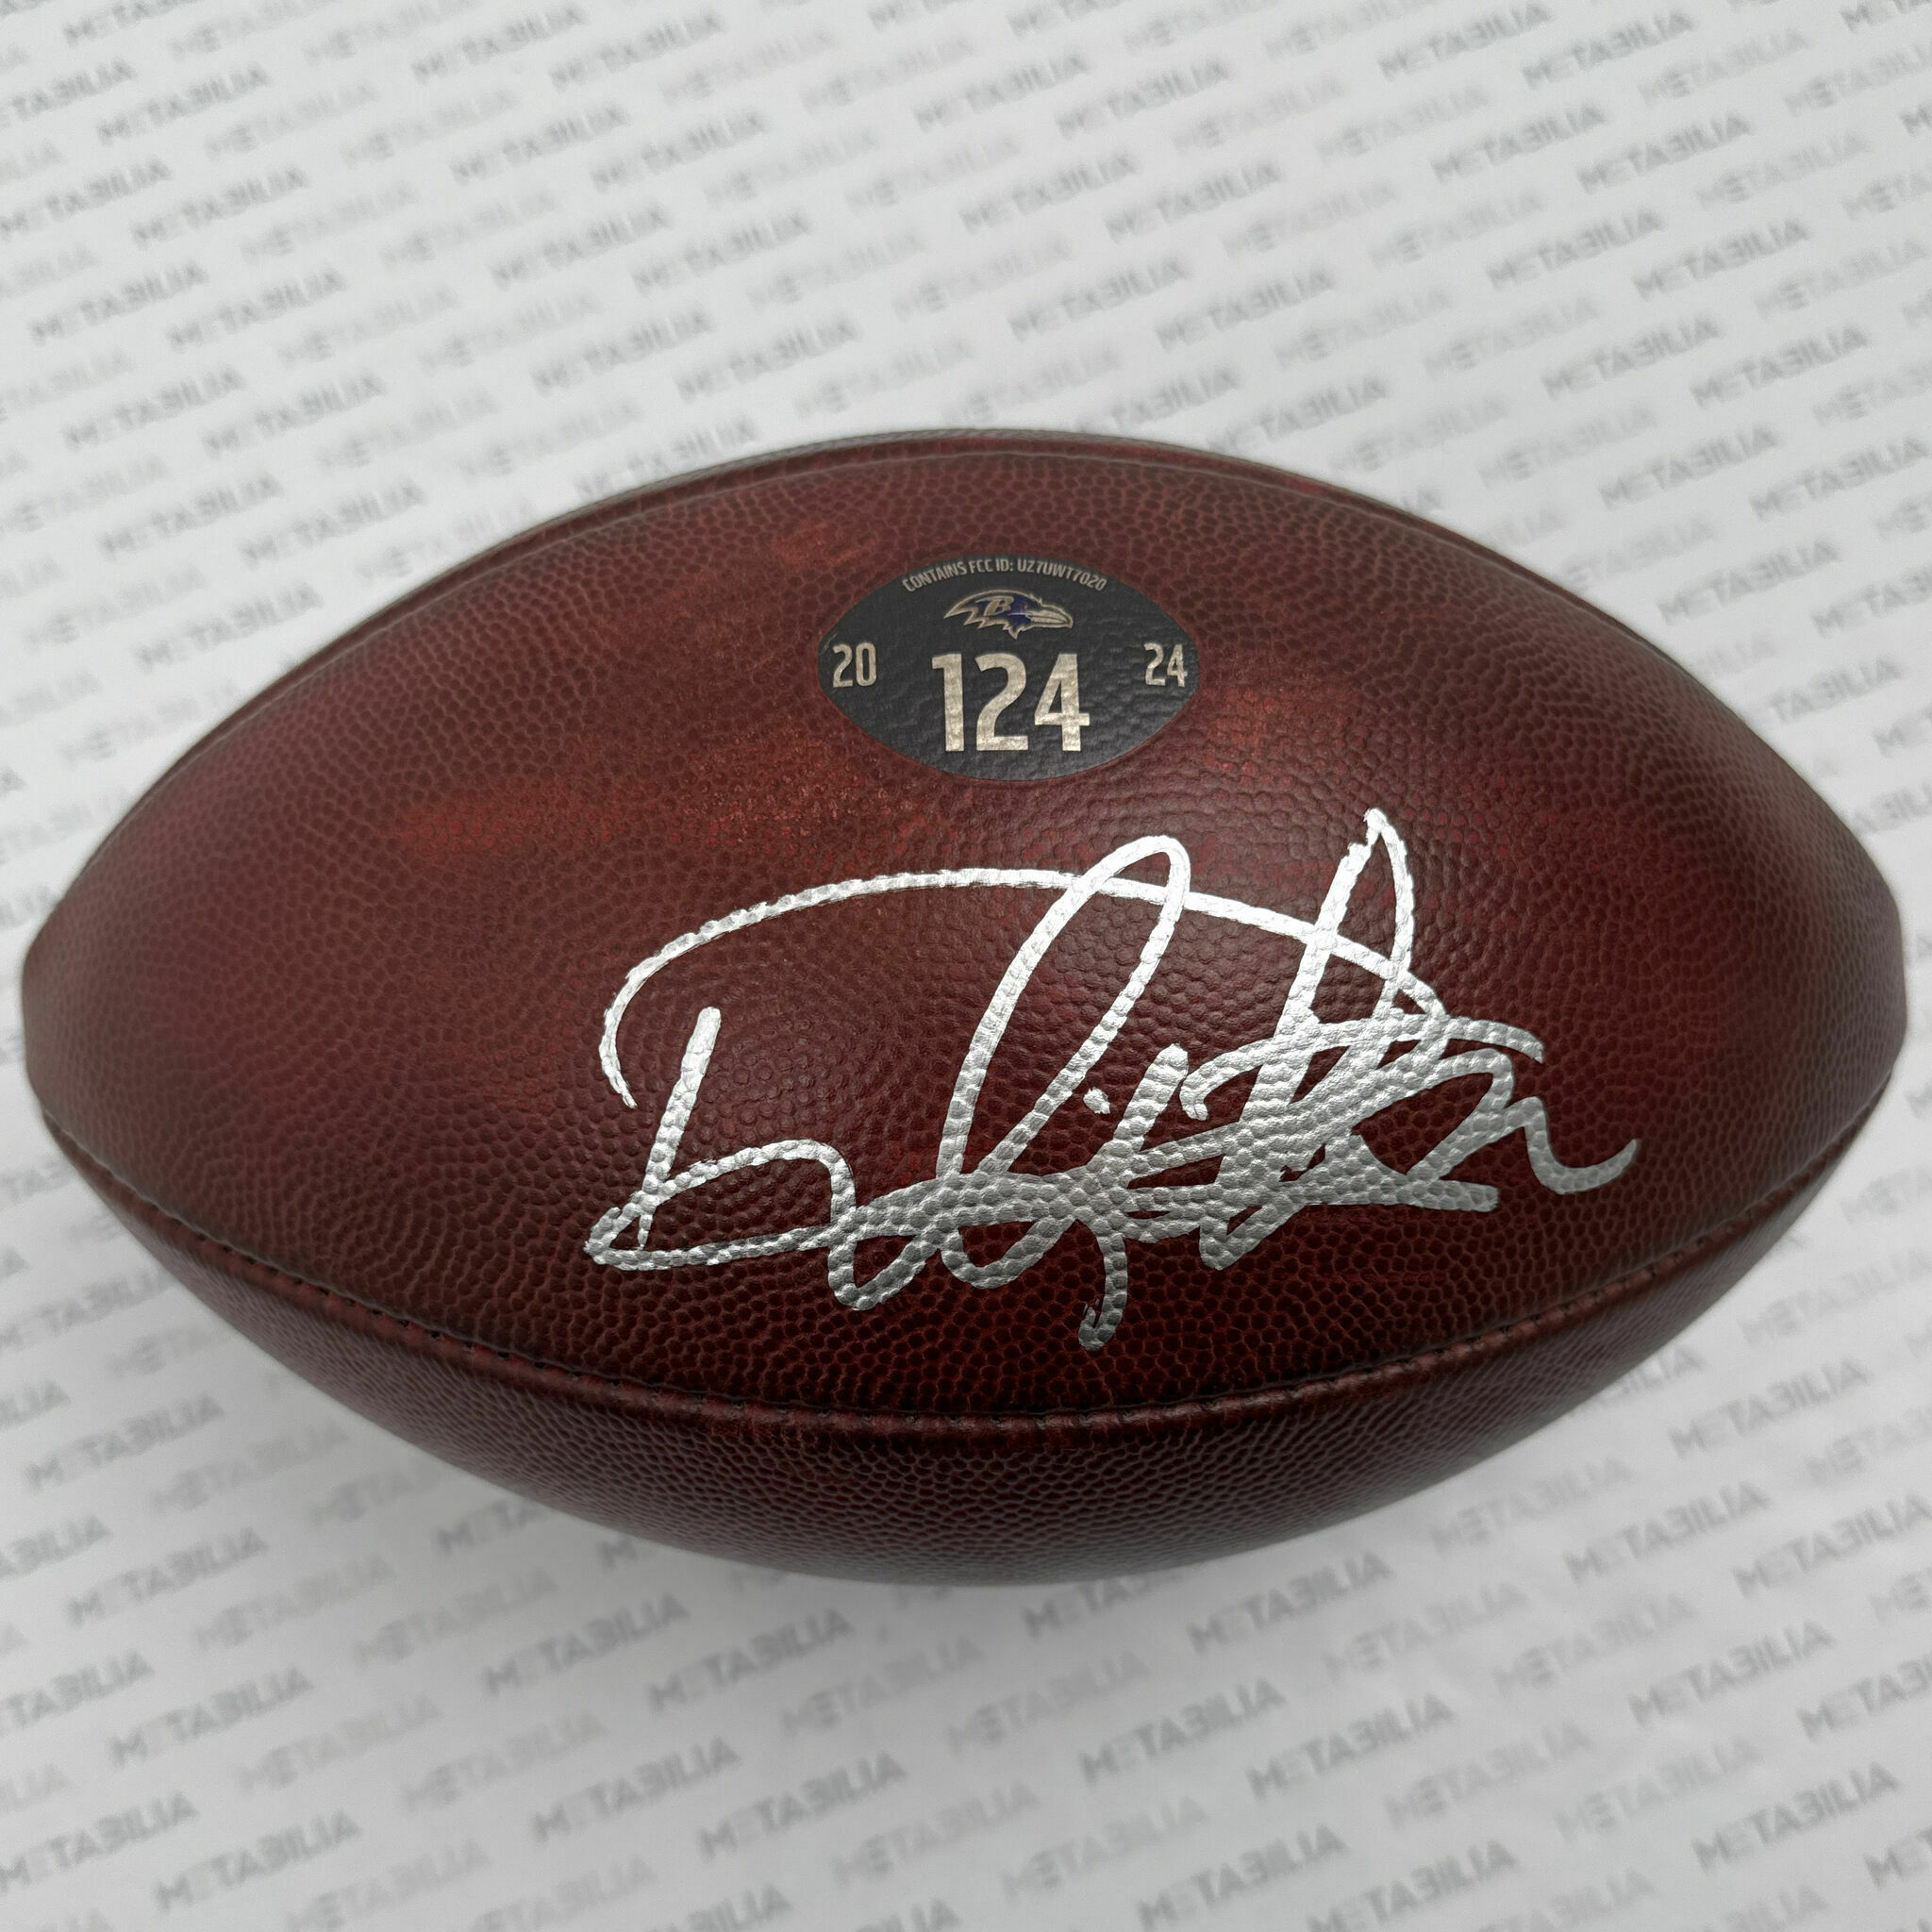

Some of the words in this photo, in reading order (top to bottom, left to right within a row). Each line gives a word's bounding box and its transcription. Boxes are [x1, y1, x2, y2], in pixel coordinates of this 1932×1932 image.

[902, 560, 968, 592] CONTAINS
[968, 558, 991, 575] FCC
[995, 558, 1014, 573] ID:
[1017, 558, 1108, 591] UZ7UWT7020
[832, 641, 877, 689] 20
[1143, 641, 1189, 688] 24
[931, 653, 1091, 752] 124
